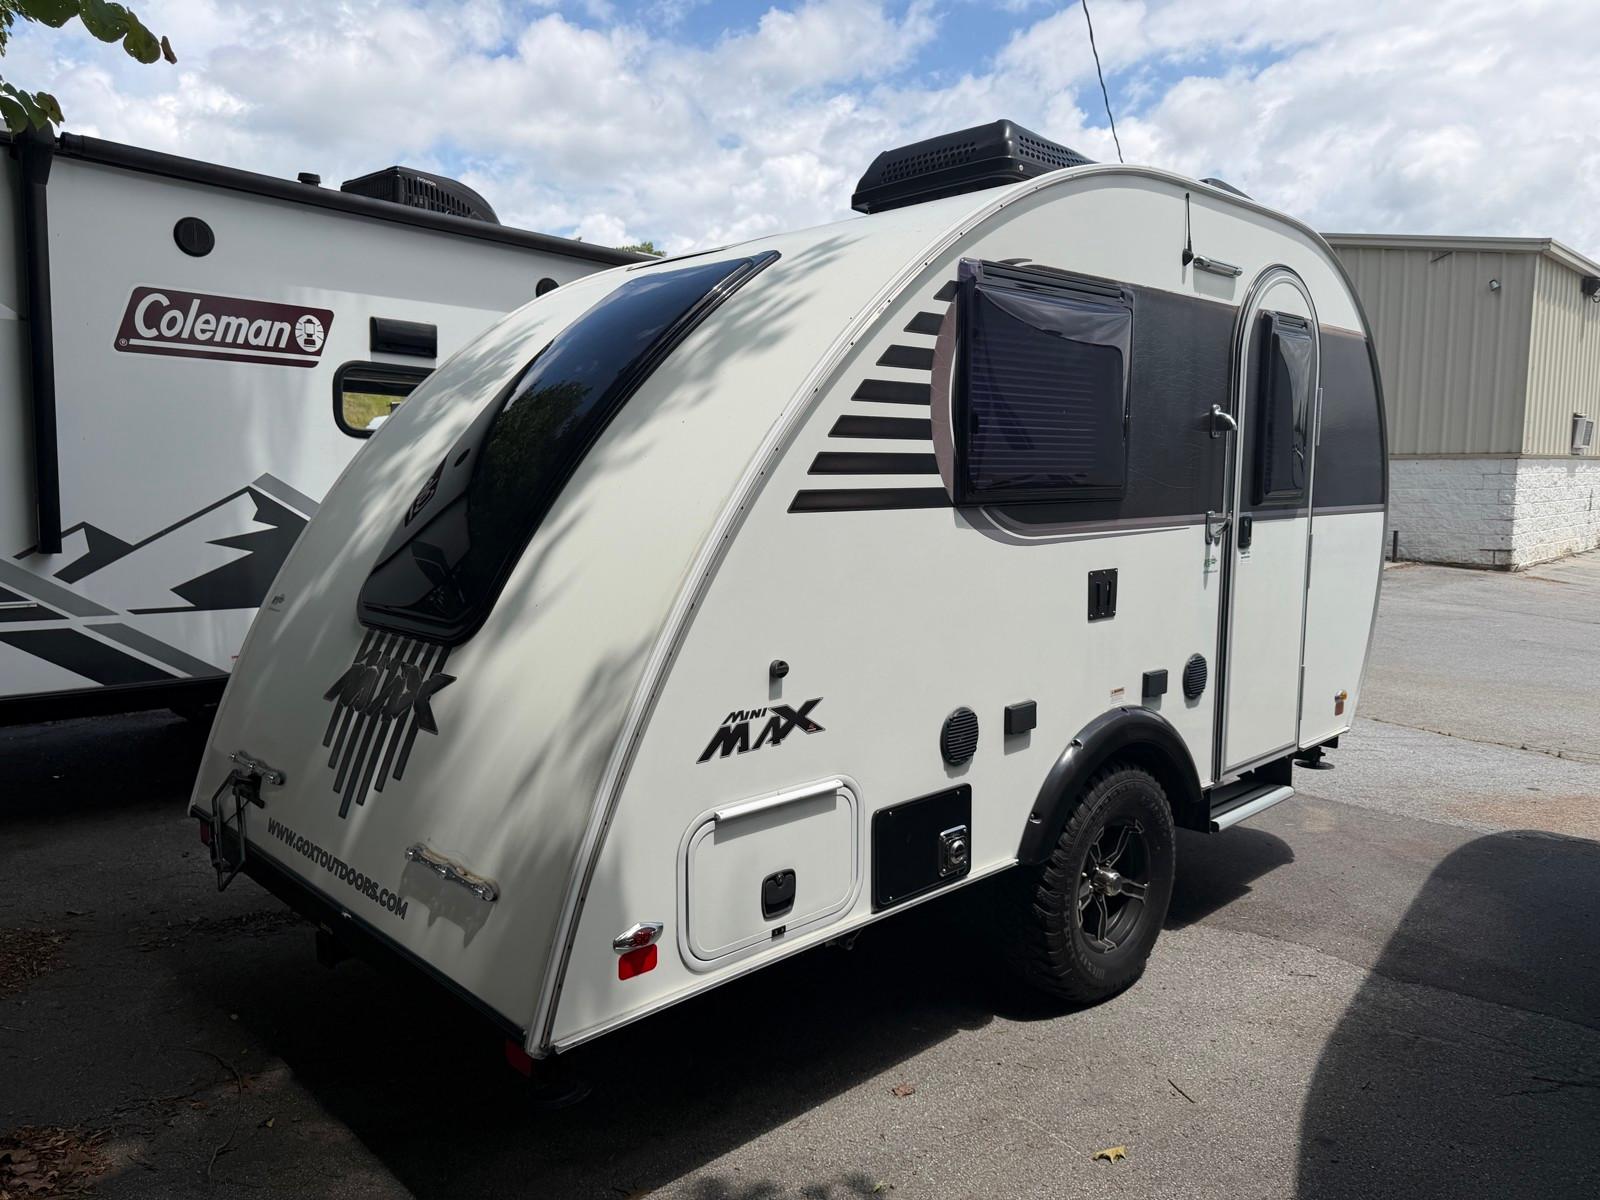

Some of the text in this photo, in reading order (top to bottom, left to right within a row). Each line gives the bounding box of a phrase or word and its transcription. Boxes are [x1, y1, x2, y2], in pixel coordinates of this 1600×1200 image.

[133, 292, 291, 348] Coleman
[696, 697, 826, 764] MAX
[722, 708, 768, 725] MINI
[268, 818, 409, 920] WWW.GOXTOUTDOORS.COM
